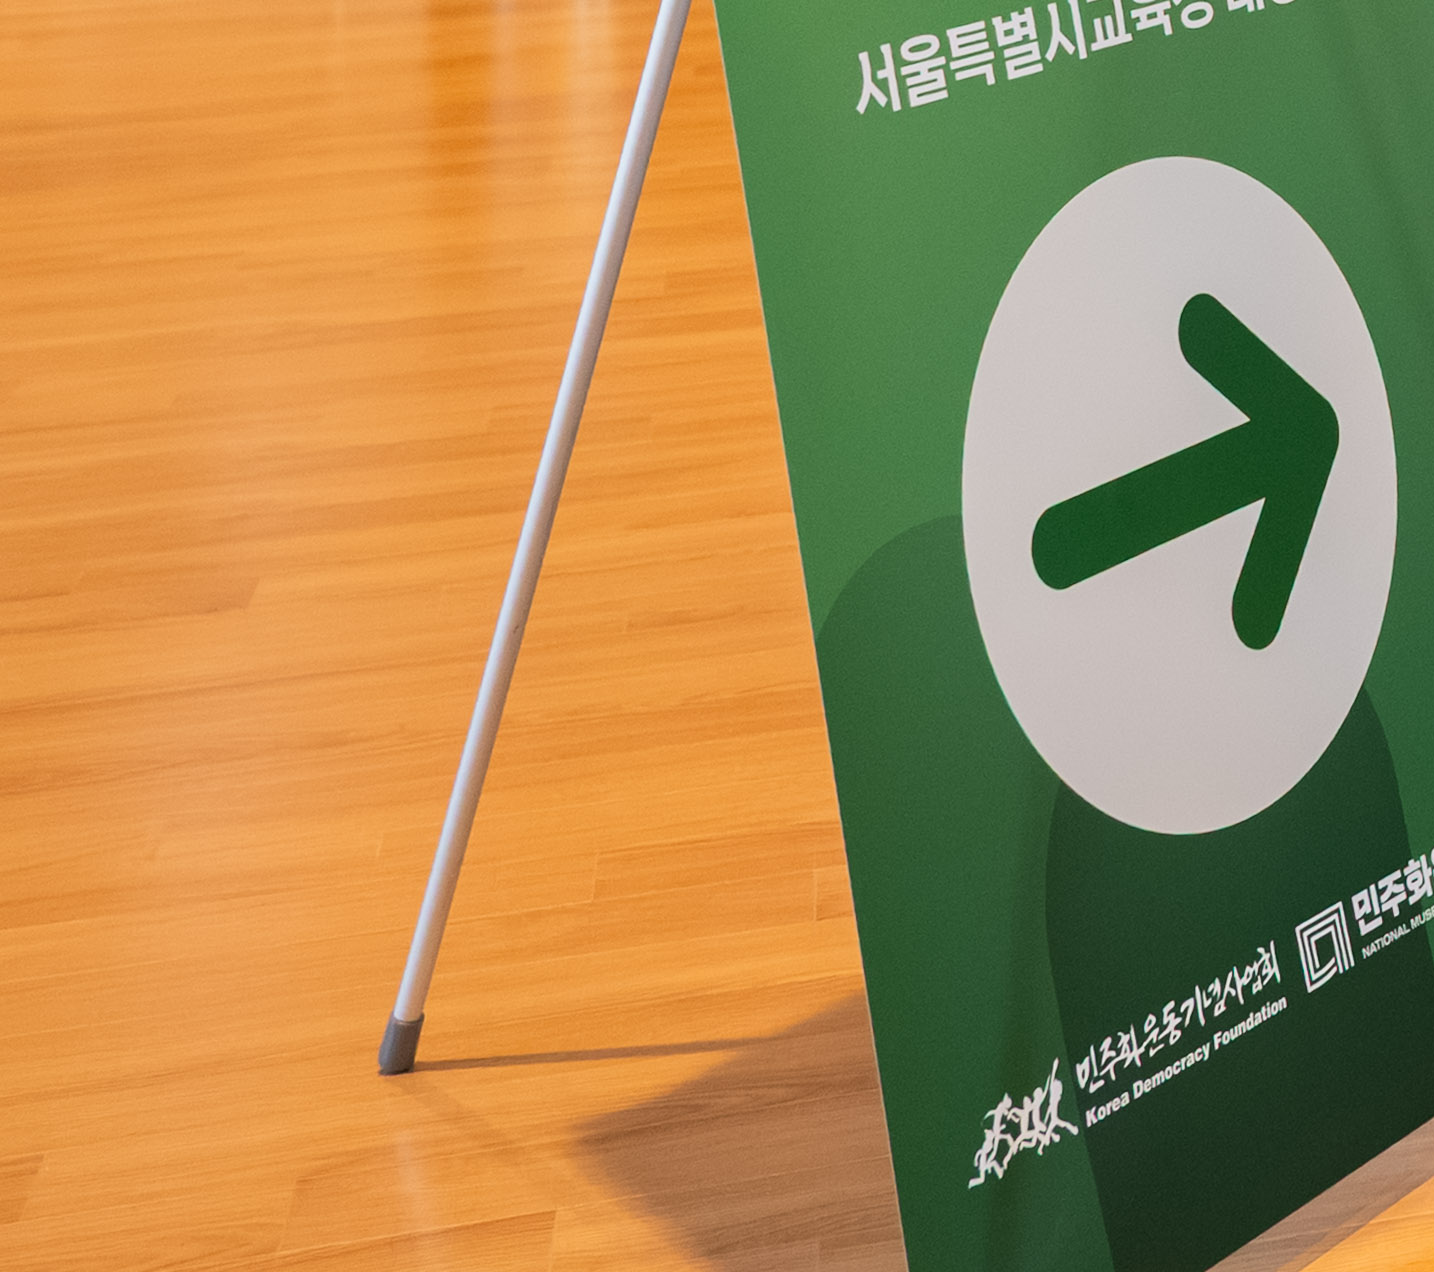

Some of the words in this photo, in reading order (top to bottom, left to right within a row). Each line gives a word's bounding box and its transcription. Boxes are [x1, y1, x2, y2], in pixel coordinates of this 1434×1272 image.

[1361, 923, 1411, 959] NATIONAL
[1075, 940, 1281, 1094] 민주화운동기념사업회
[1085, 1091, 1130, 1128] Korea
[1132, 1042, 1210, 1100] Democracy
[1213, 996, 1288, 1051] Foundation
